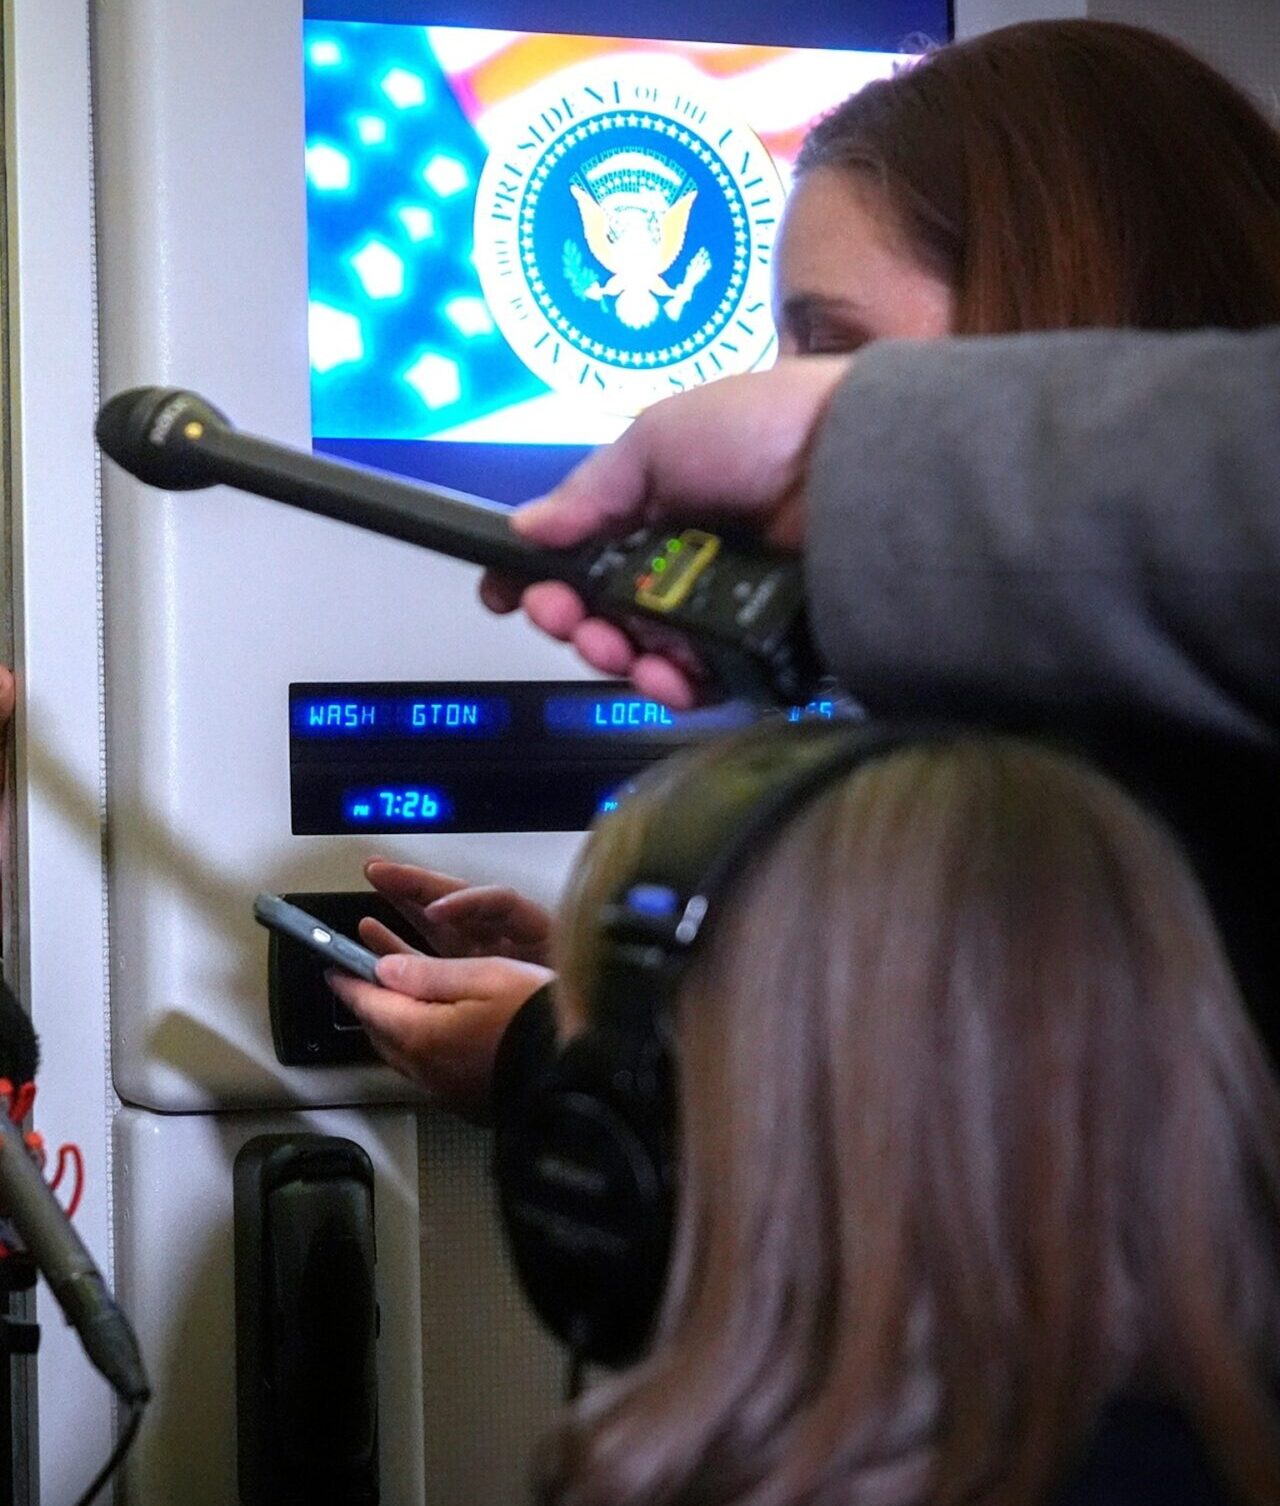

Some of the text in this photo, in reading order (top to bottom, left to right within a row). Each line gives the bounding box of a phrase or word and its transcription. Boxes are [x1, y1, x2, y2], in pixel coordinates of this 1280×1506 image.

[491, 80, 621, 222] PRESIDENT
[718, 128, 776, 265] UNITED
[595, 702, 673, 726] LOCAL
[353, 792, 437, 818] PM 7:26
